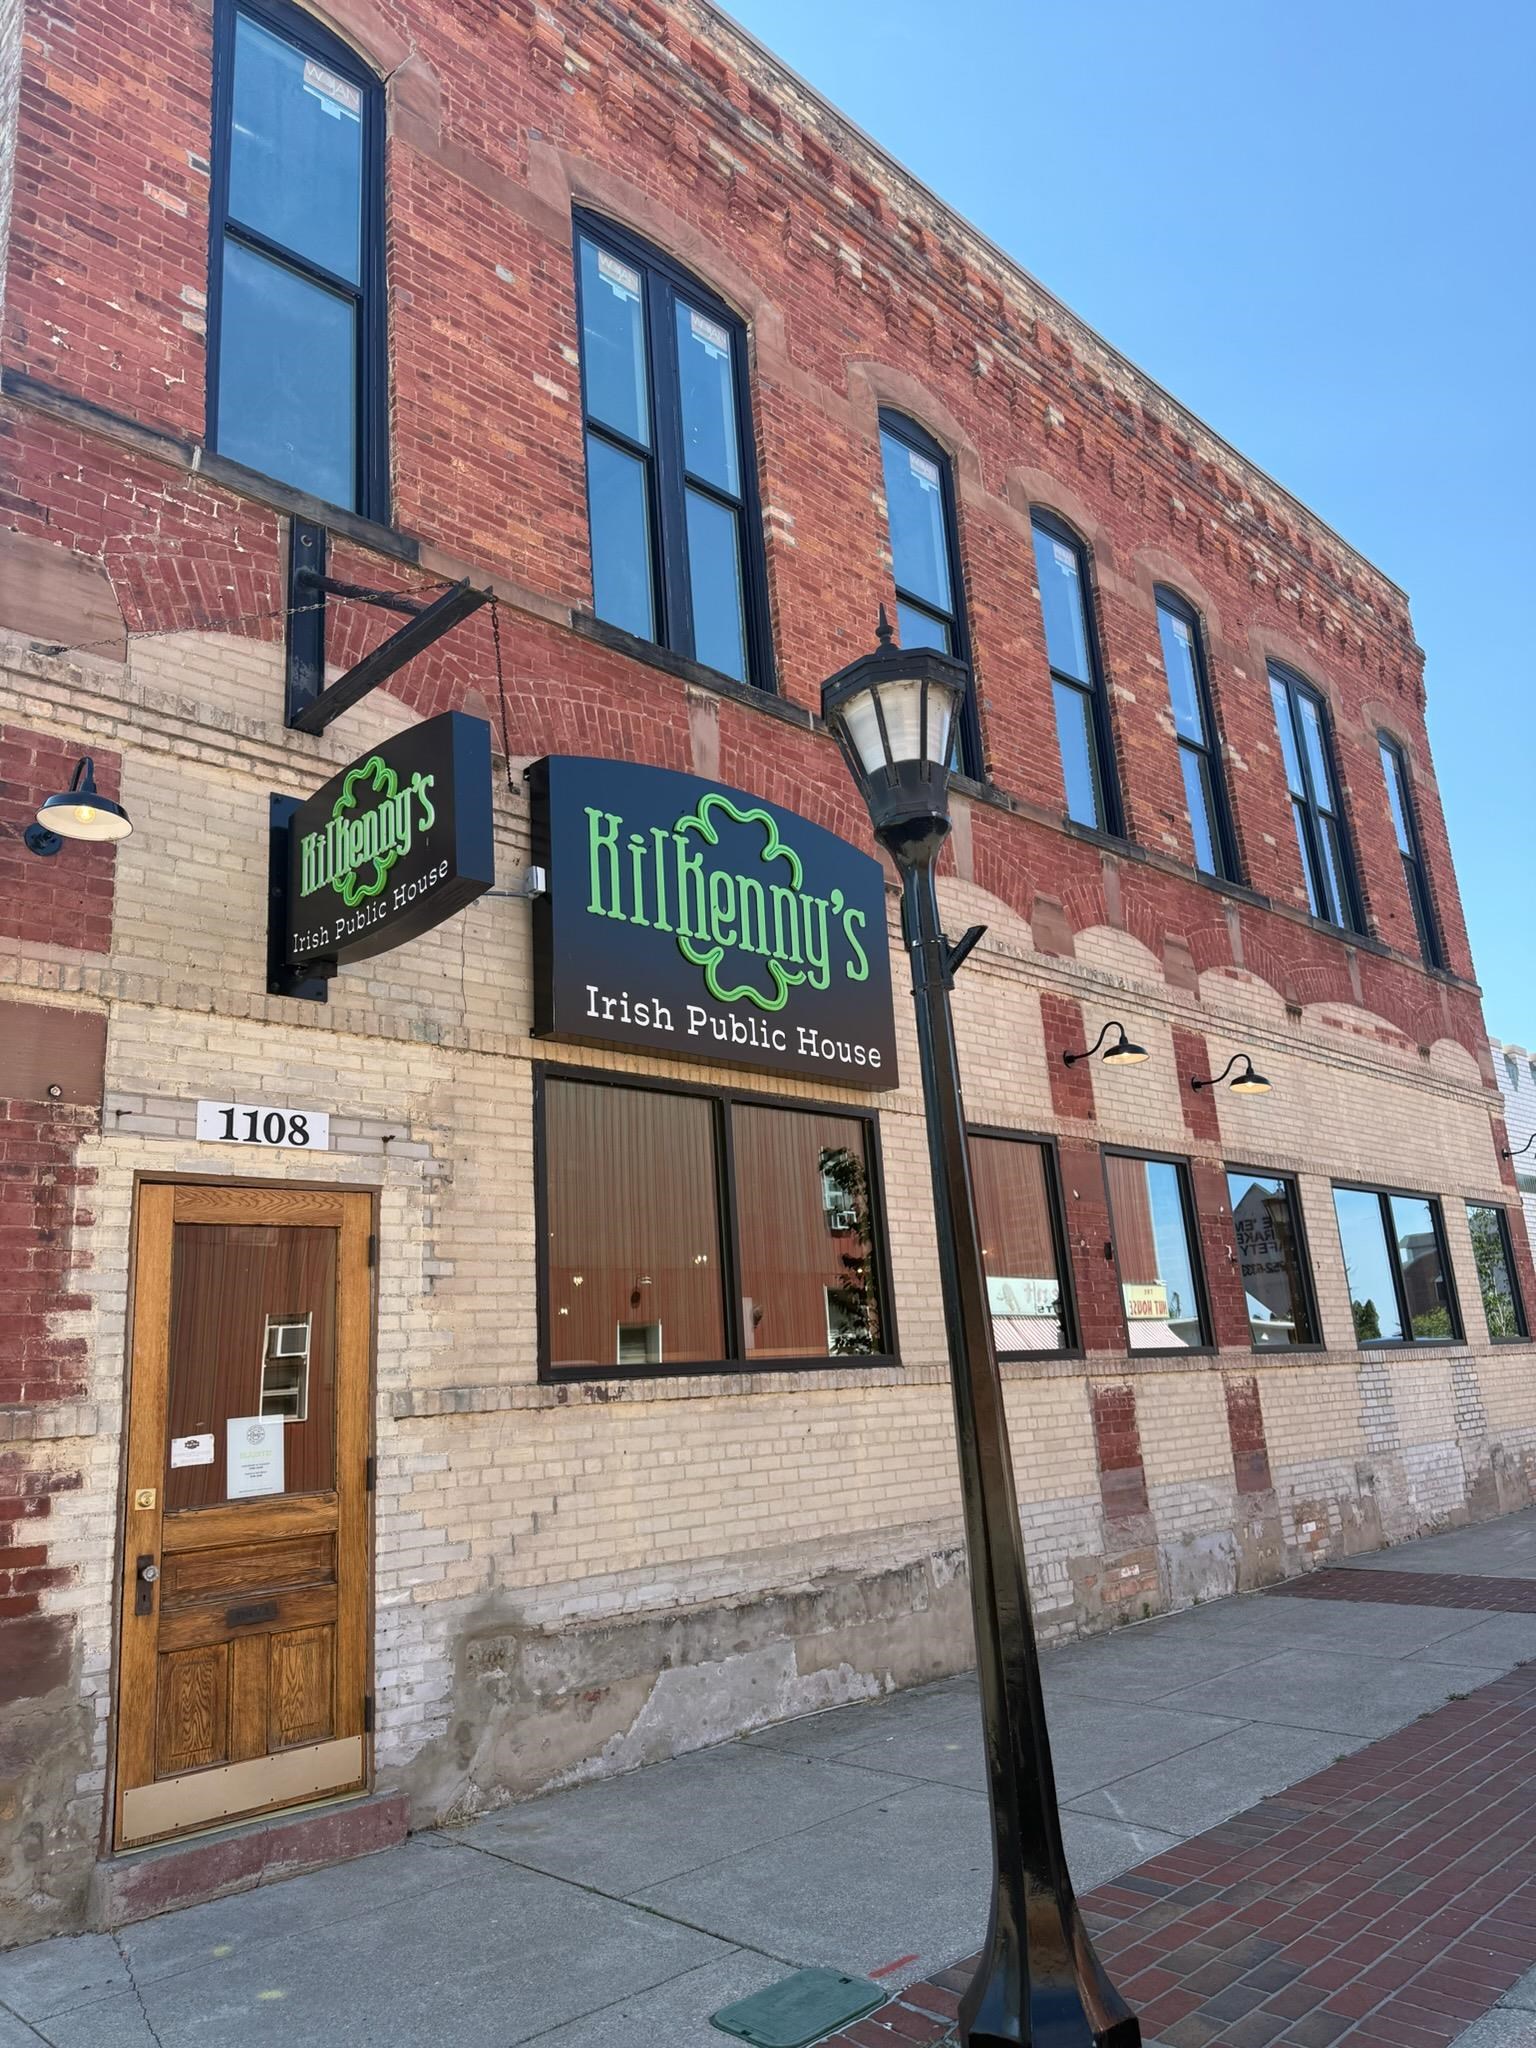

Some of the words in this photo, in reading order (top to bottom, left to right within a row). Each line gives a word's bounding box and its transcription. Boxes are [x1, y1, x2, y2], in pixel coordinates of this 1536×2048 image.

[299, 771, 436, 898] Kilkenny's
[293, 926, 330, 953] Irish
[335, 900, 388, 940] Public
[393, 858, 449, 911] House
[584, 806, 870, 989] Kilkenny's
[585, 985, 676, 1033] Irish
[687, 1005, 788, 1053] Public
[796, 1026, 882, 1069] House
[218, 1107, 310, 1146] 1108
